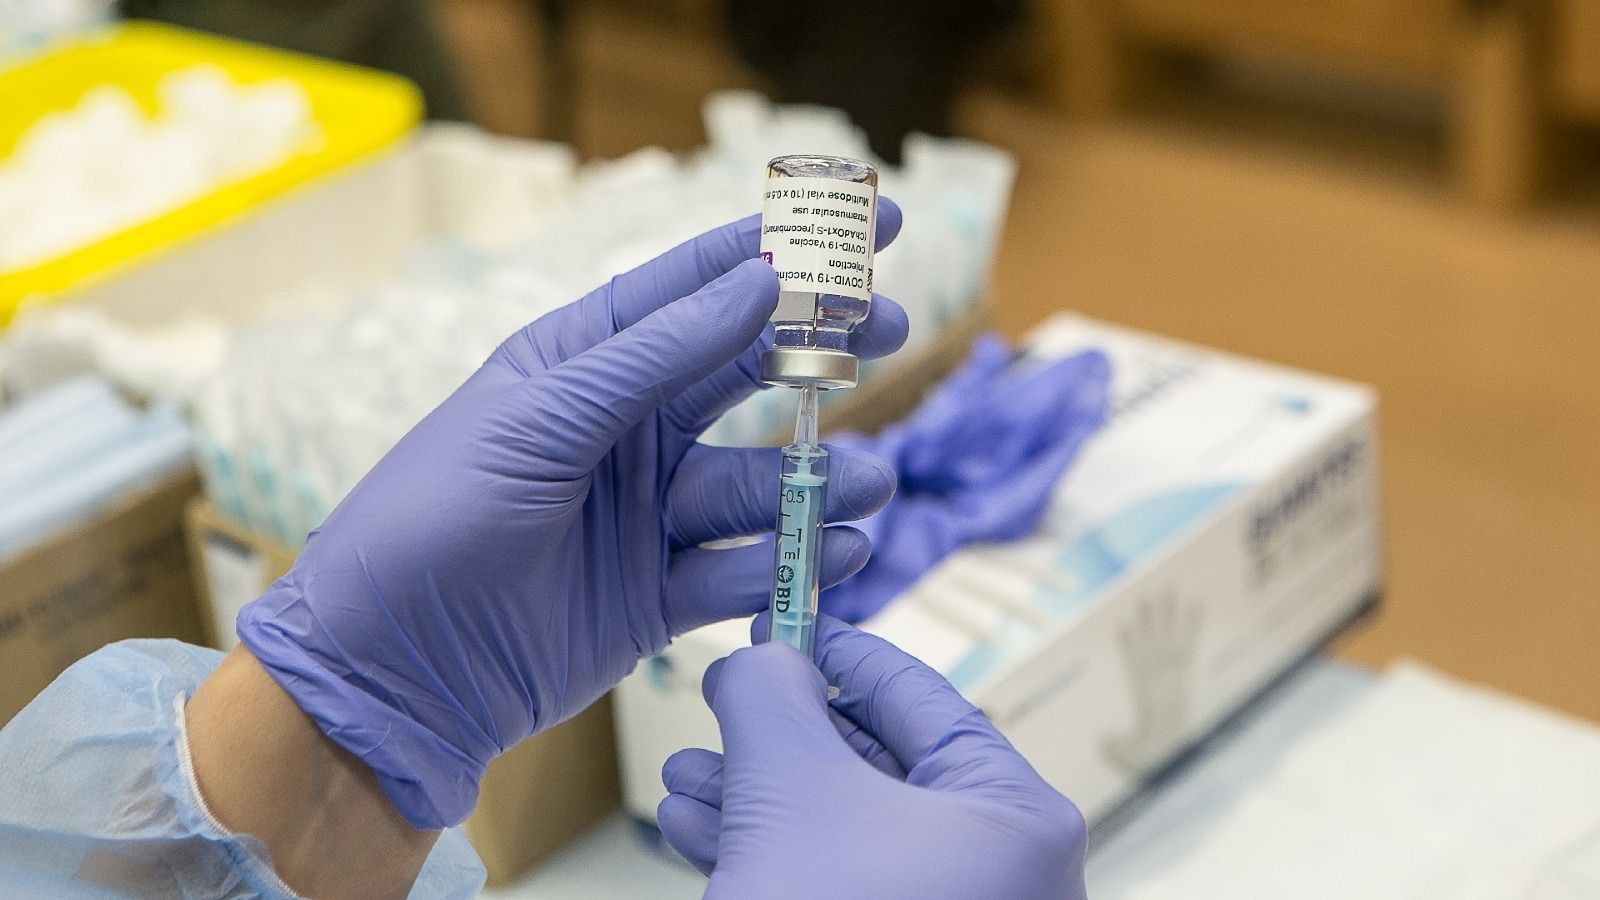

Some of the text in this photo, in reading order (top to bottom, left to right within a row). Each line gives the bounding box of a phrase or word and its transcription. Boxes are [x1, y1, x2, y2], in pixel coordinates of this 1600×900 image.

[790, 188, 805, 199] (10
[807, 190, 825, 198] vial
[827, 191, 869, 207] Multidose
[811, 209, 868, 223] Intramuscular
[816, 226, 867, 241] (ChAdOx1-S
[789, 238, 866, 254] COVID-19 Vaccine
[828, 259, 865, 273] Injection
[817, 273, 864, 289] COVID-19
[786, 490, 805, 504] 0.5
[796, 528, 802, 544] 1
[784, 547, 800, 560] ml
[775, 587, 791, 614] BD
